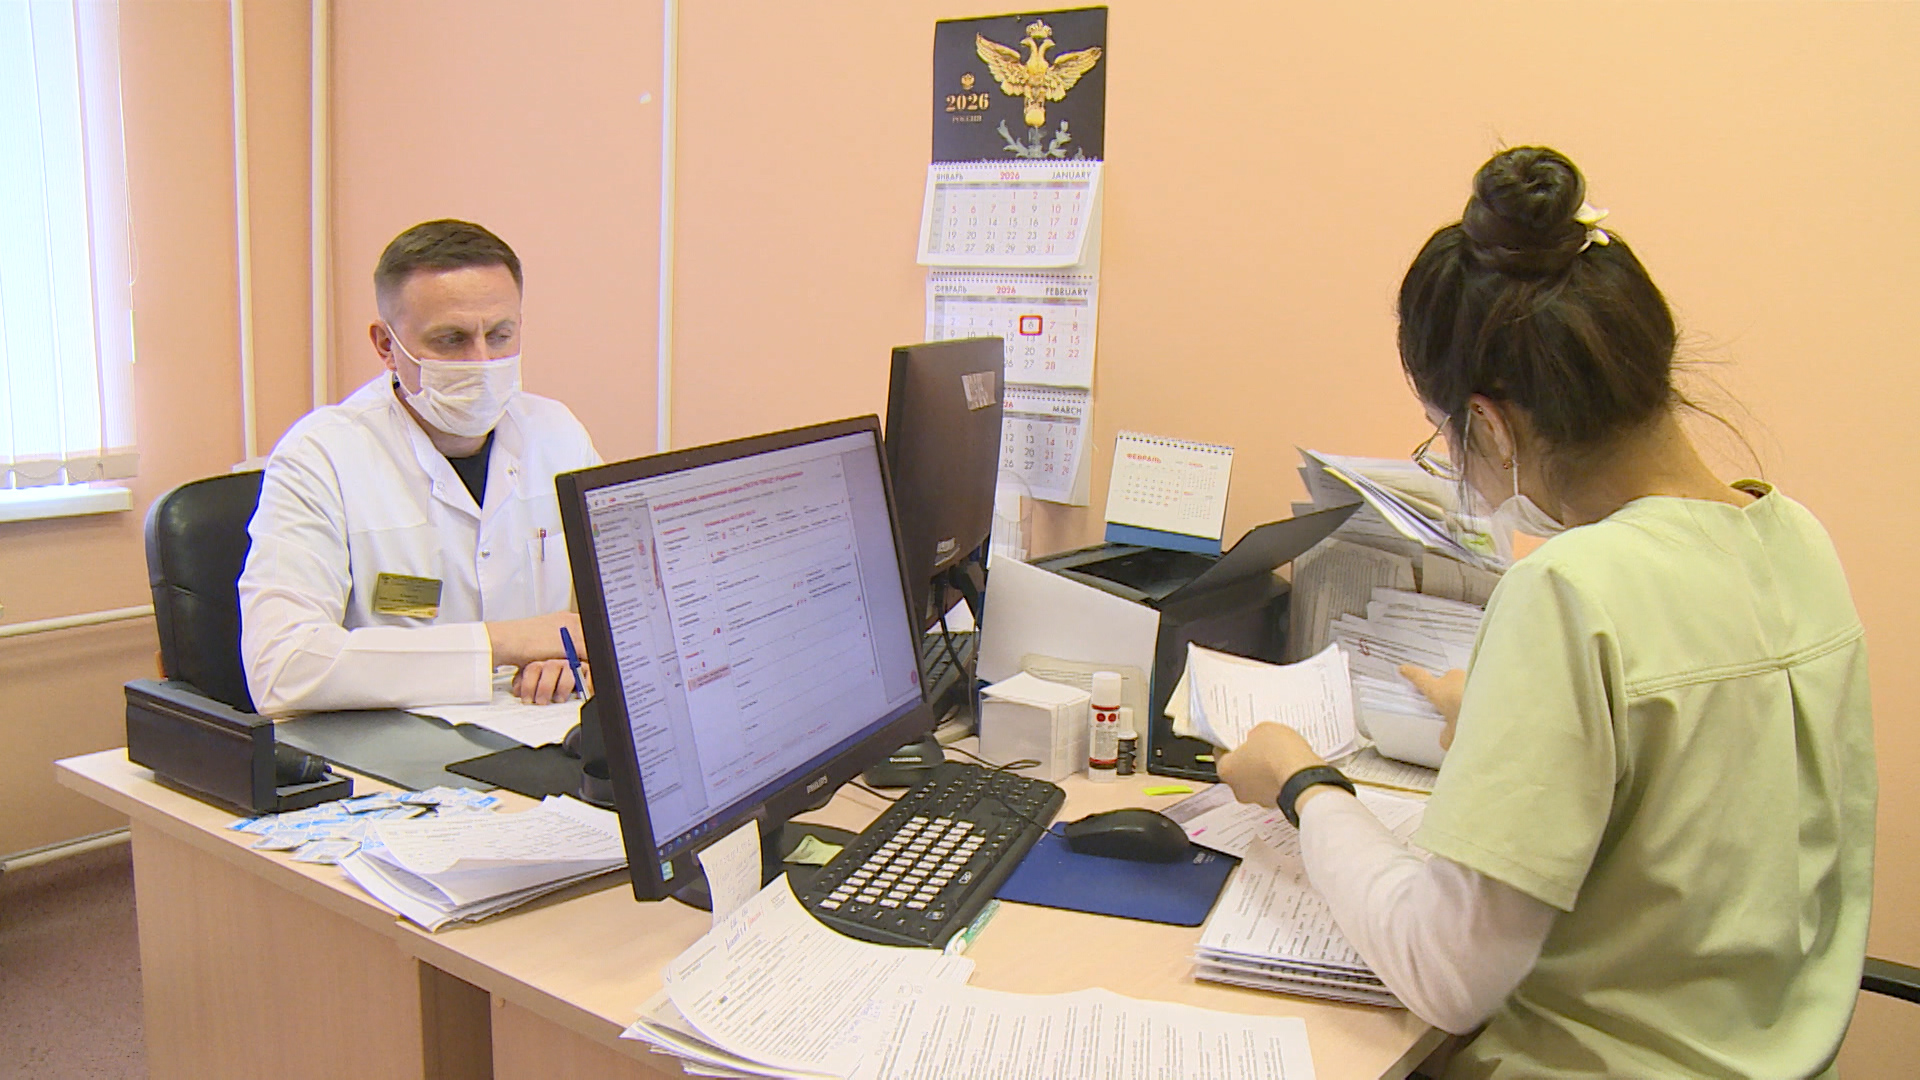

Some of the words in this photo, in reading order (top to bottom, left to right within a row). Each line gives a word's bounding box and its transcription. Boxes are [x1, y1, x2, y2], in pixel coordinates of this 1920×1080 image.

[945, 93, 990, 112] 2026
[1000, 171, 1019, 180] 2026
[1051, 171, 1091, 180] JANUARY
[1052, 204, 1061, 213] 10
[1072, 204, 1080, 213] 11
[949, 217, 958, 226] 12
[989, 217, 997, 226] 14
[1009, 217, 1018, 227] 15
[1030, 217, 1038, 227] 16
[1050, 217, 1059, 226] 17
[948, 231, 957, 239] 19
[966, 231, 976, 239] 20
[987, 231, 995, 239] 21
[1007, 231, 1016, 239] 22
[1027, 231, 1036, 239] 23
[1048, 231, 1057, 239] 24
[945, 243, 955, 252] 26
[965, 243, 975, 252] 27
[985, 243, 995, 253] 28
[1005, 244, 1015, 253] 29
[1026, 244, 1036, 253] 30
[1045, 243, 1054, 253] 31
[996, 286, 1016, 294] 2026
[1045, 287, 1088, 296] FEBRUARY
[1006, 332, 1014, 341] 12
[1048, 335, 1057, 343] 14
[1071, 336, 1080, 345] 15
[1005, 345, 1014, 353] 19
[1025, 347, 1035, 355] 20
[1045, 348, 1055, 357] 21
[1068, 349, 1079, 357] 22
[1024, 360, 1034, 369] 27
[1045, 361, 1055, 369] 28
[1052, 406, 1081, 415] MARCH
[1005, 433, 1014, 441] 12
[1026, 435, 1034, 443] 13
[1046, 438, 1055, 446] 14
[1066, 440, 1073, 449] 15
[1024, 447, 1034, 457] 20
[1044, 450, 1054, 459] 21
[1064, 453, 1071, 461] 22
[1004, 459, 1014, 467] 26
[1024, 461, 1035, 470] 27
[1044, 463, 1054, 472] 28
